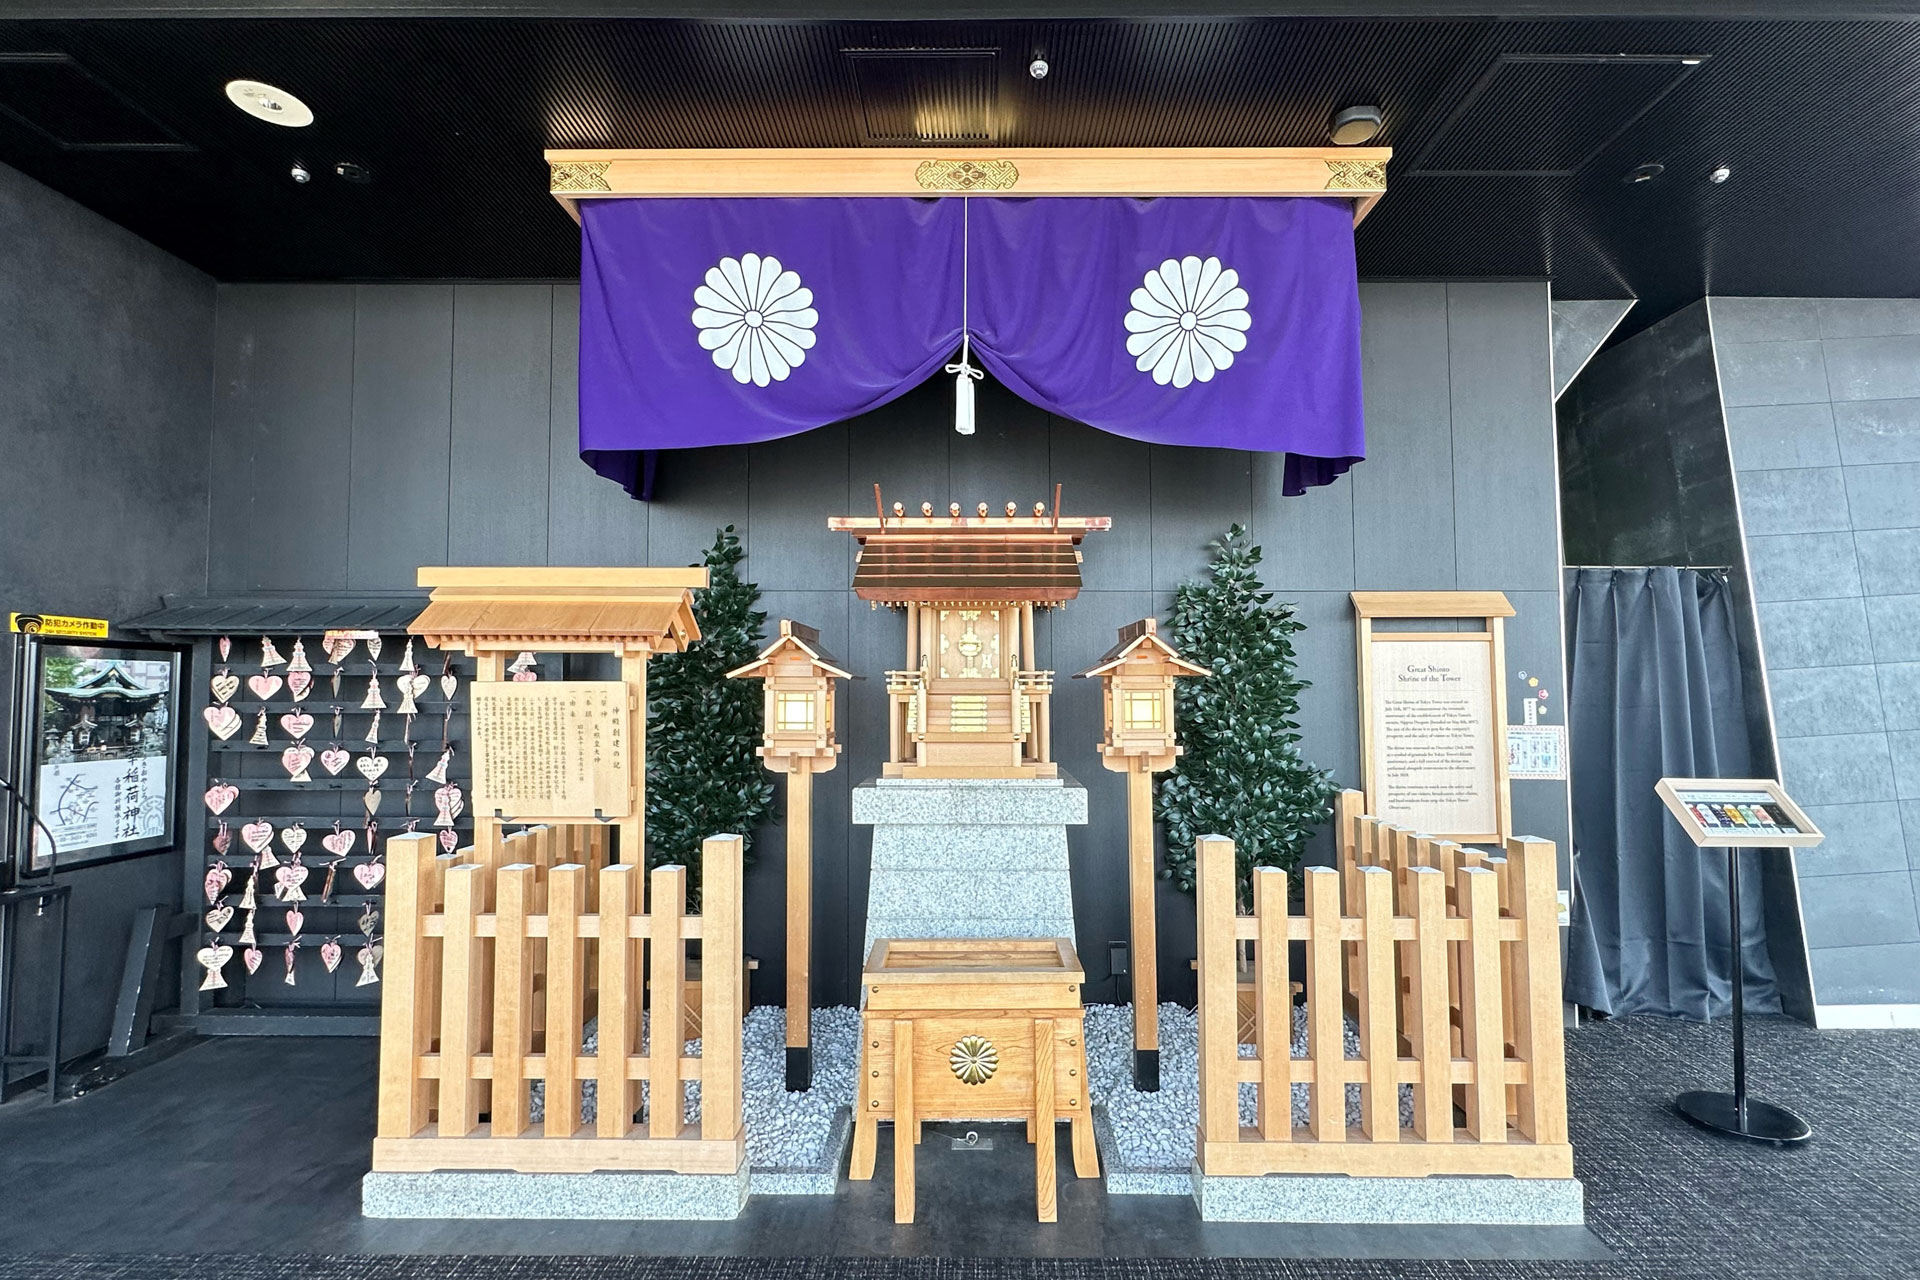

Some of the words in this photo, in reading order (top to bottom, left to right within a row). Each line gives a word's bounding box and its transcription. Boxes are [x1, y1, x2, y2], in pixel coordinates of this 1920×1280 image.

[45, 619, 104, 629] 防犯カメラ作動中
[1399, 674, 1419, 682] Shrine
[1429, 674, 1439, 682] the
[1441, 674, 1461, 682] Tower
[612, 707, 620, 769] 神殿創建の記
